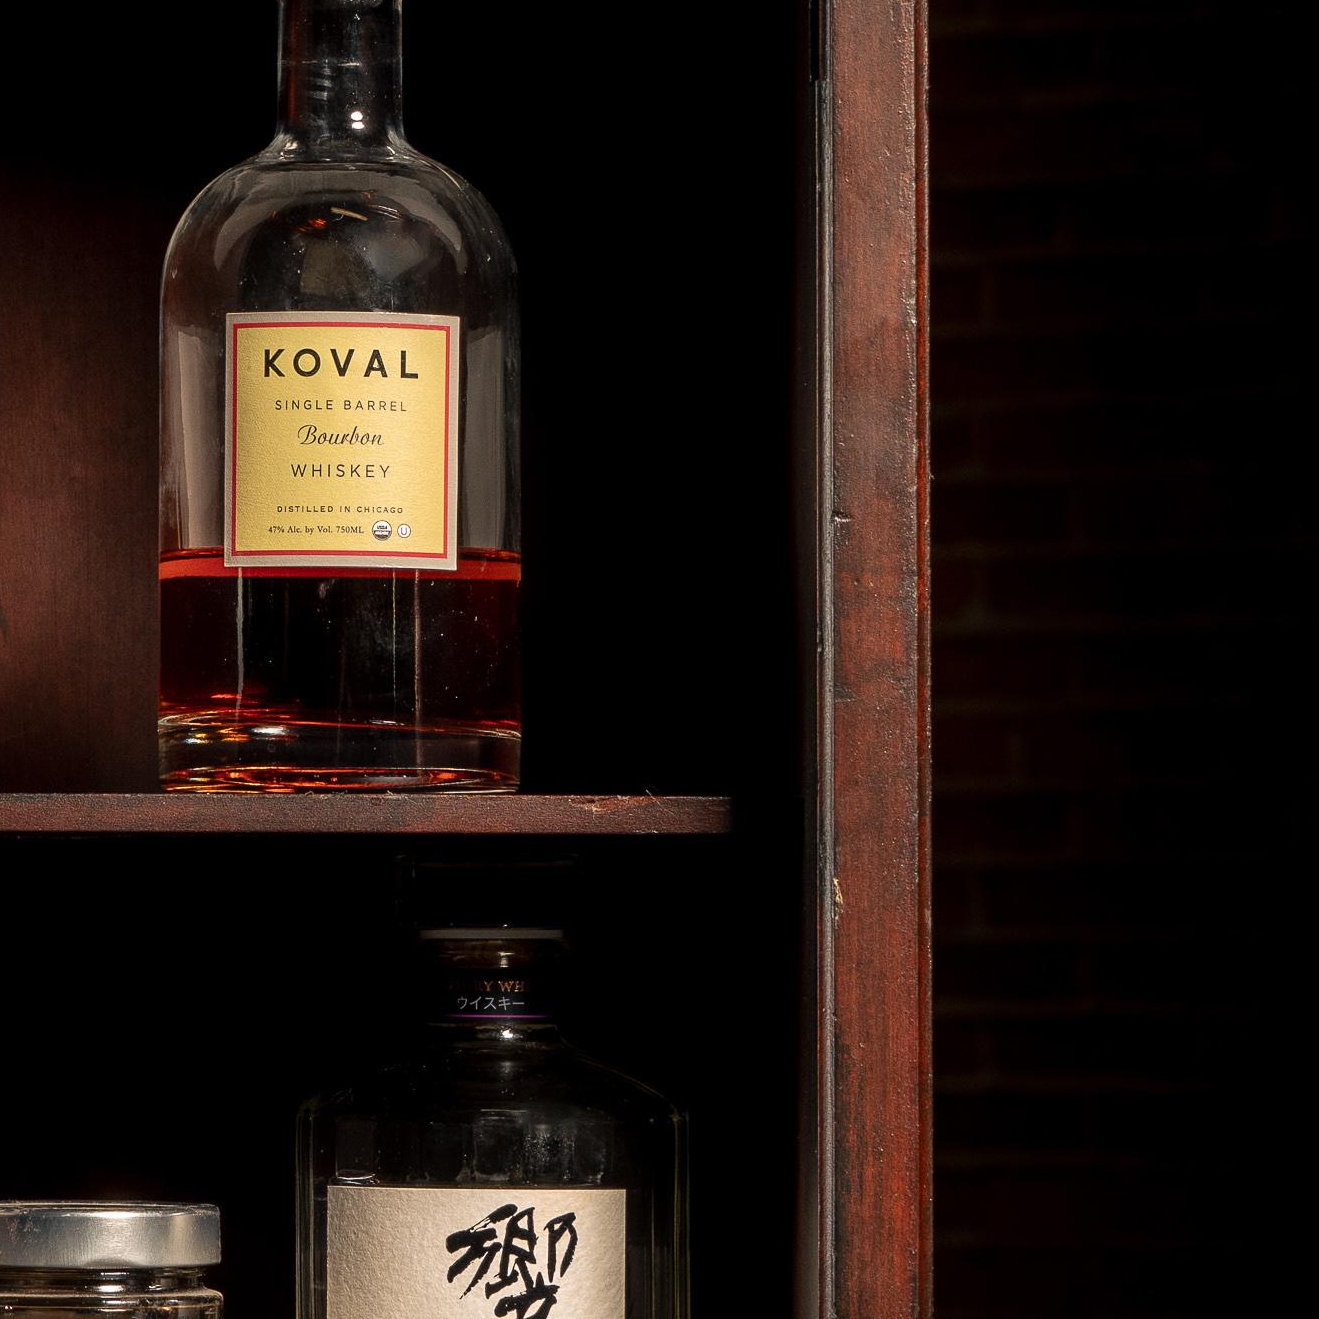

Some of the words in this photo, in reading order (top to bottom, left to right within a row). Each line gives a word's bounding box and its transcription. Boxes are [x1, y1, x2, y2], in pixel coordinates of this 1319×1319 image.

[263, 347, 419, 380] KOVAL
[274, 399, 334, 411] SINGLE
[342, 400, 407, 412] BARREL
[297, 424, 385, 446] Bourbon
[290, 463, 390, 479] WHISKEY
[276, 505, 334, 514] DISTILLED
[339, 505, 351, 514] IN
[356, 506, 404, 514] CHICAGO
[268, 525, 284, 534] 47%
[287, 525, 302, 534] Alc.
[304, 525, 314, 535] by
[317, 525, 332, 534] Vol.
[457, 995, 525, 1010] ウイスキー
